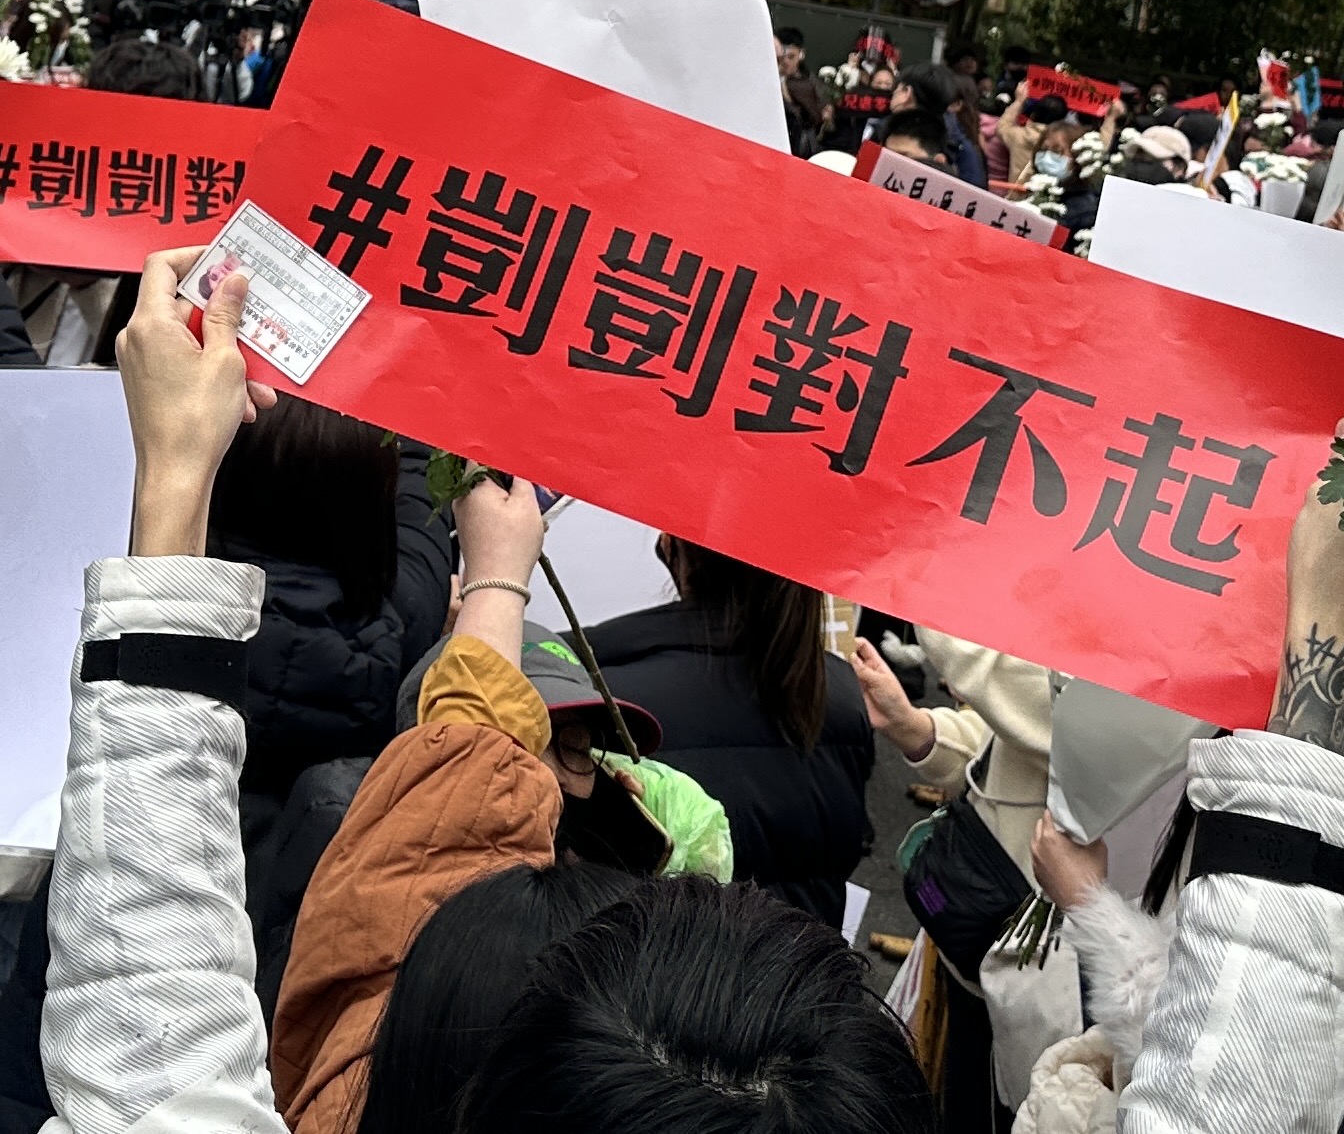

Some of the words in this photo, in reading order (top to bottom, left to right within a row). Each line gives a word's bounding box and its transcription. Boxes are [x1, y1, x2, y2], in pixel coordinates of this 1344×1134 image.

[308, 144, 1278, 597] #剴剴對不起
